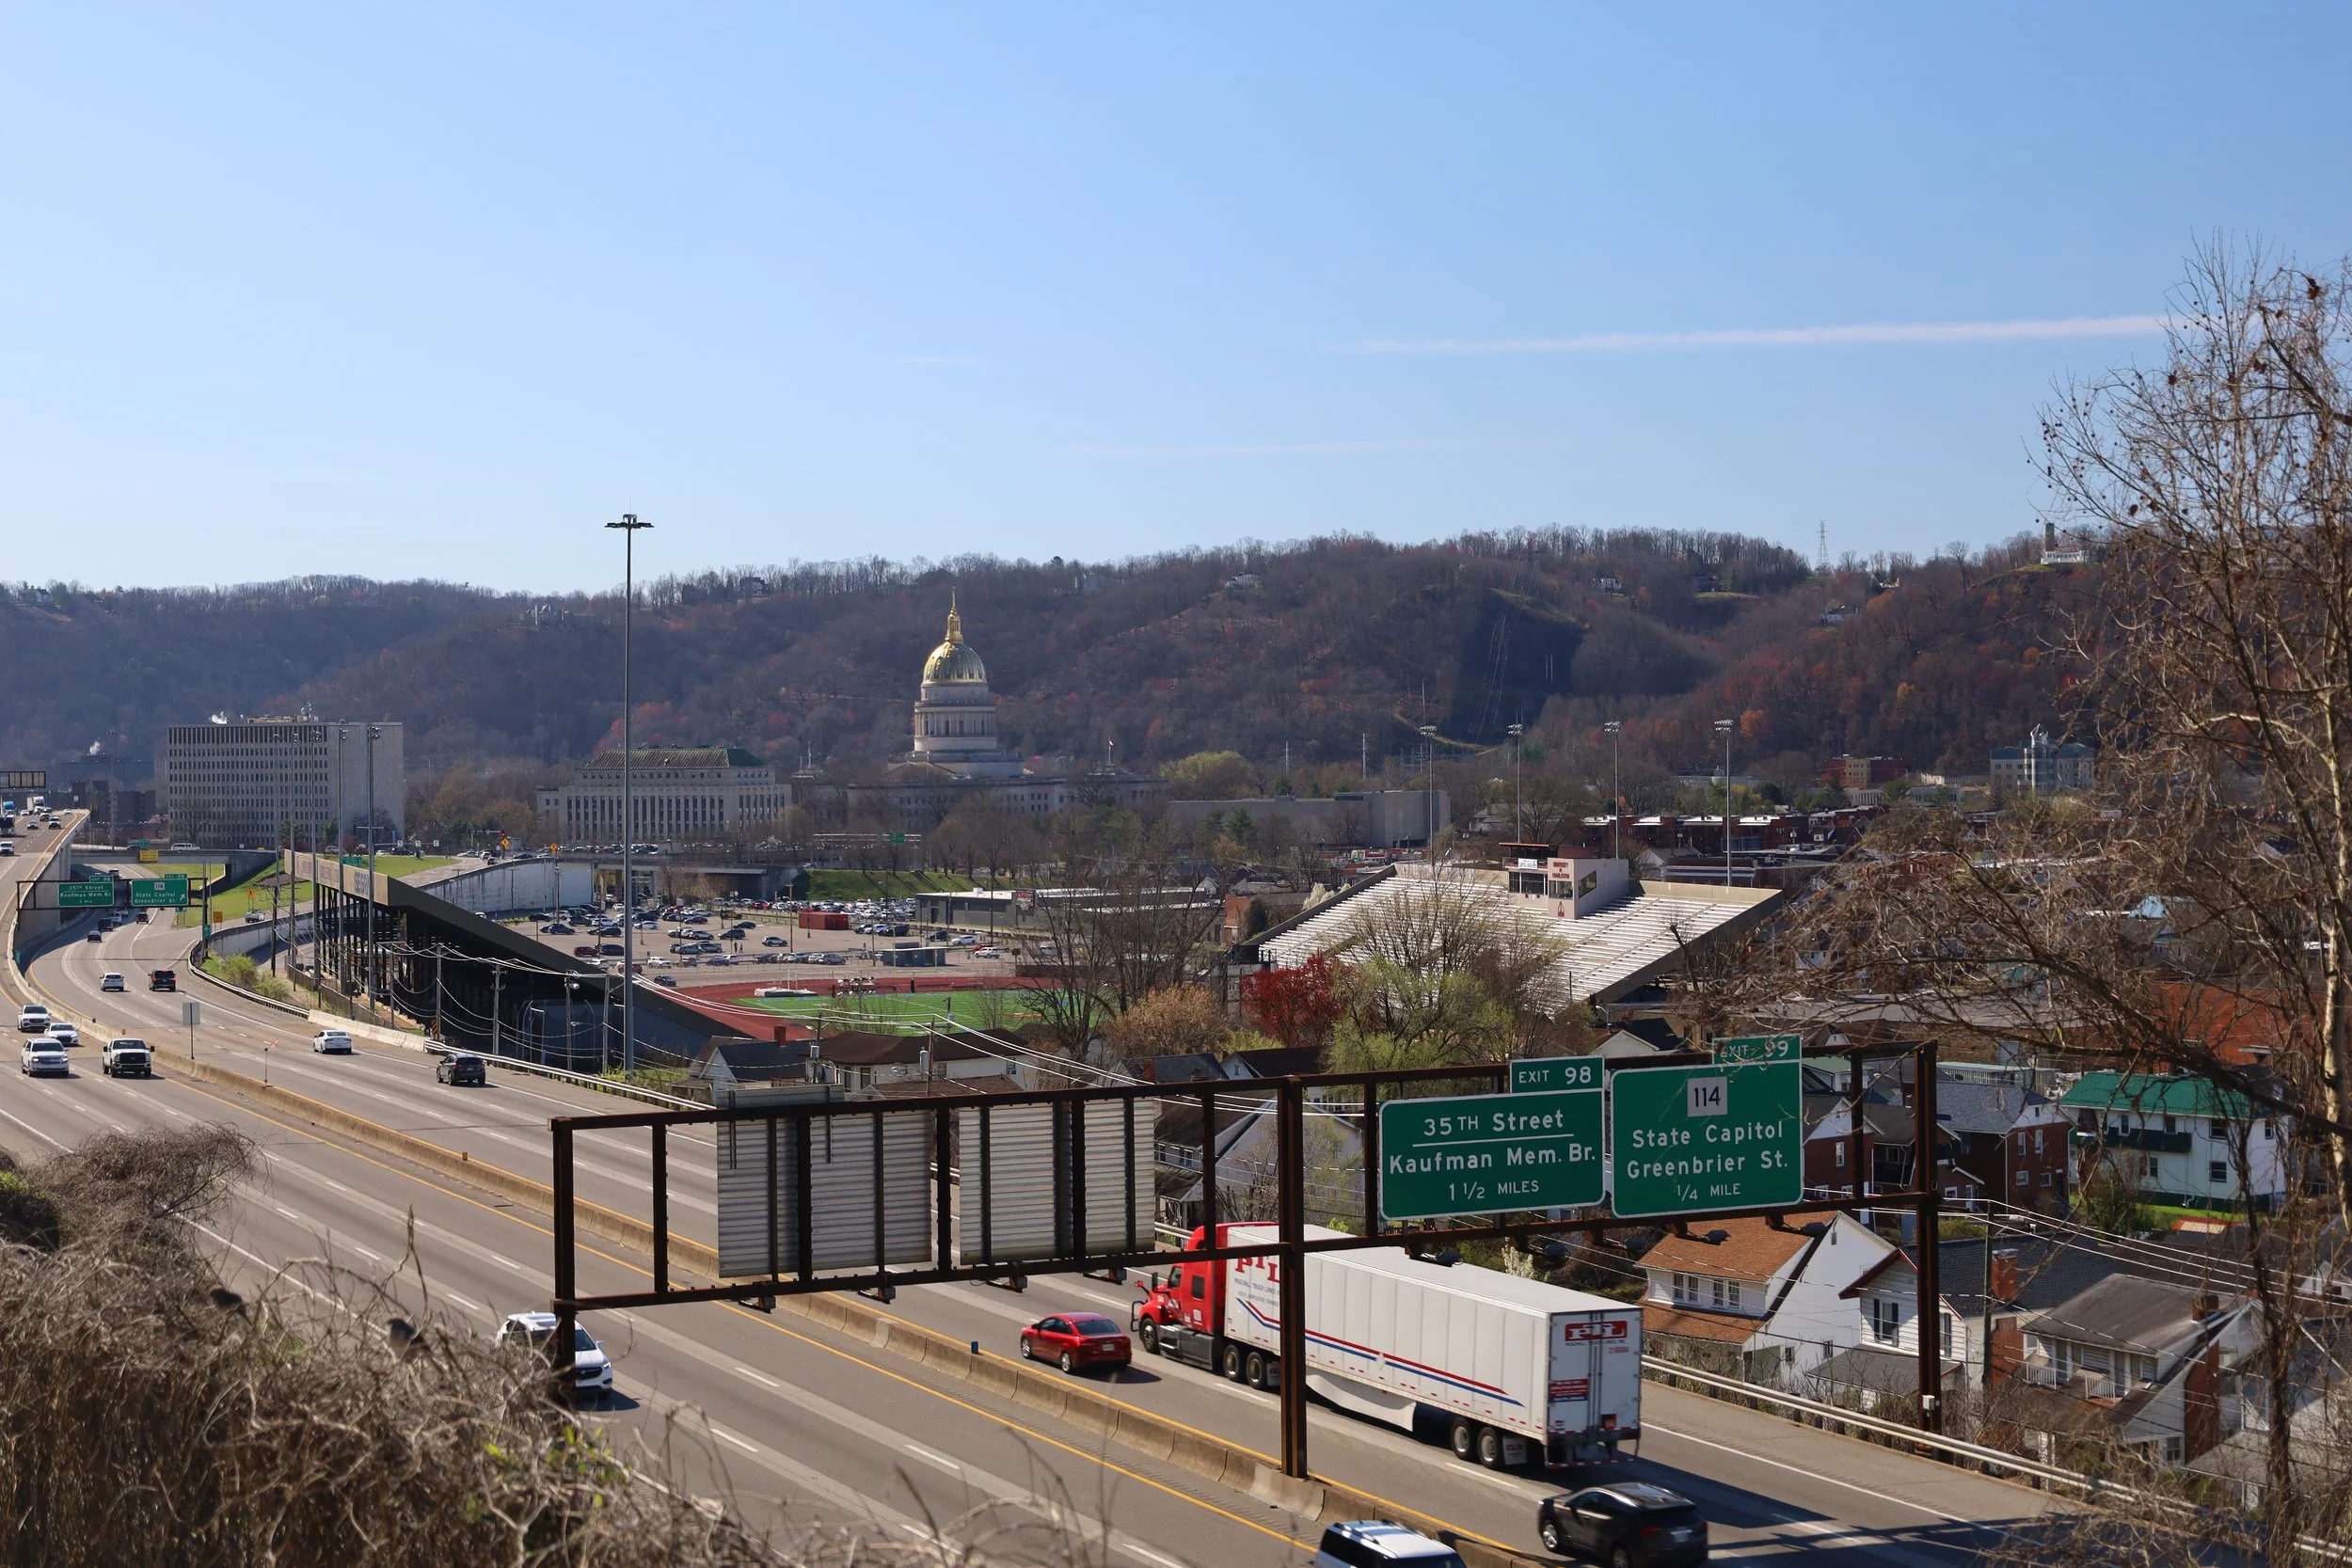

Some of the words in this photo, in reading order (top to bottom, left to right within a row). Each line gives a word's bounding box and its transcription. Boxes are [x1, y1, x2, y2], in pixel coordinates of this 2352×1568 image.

[1720, 1045, 1748, 1058] EXIT
[1764, 1040, 1789, 1058] 99
[1518, 1069, 1550, 1084] EXIT
[1565, 1066, 1592, 1085] 98
[1693, 1086, 1721, 1108] 114
[1423, 1115, 1479, 1136] 35TH
[1492, 1109, 1564, 1132] Street
[1632, 1128, 1691, 1148] State
[1705, 1121, 1783, 1144] Capitol
[1390, 1152, 1492, 1175] Kaufman
[1507, 1147, 1562, 1166] Mem.
[1569, 1143, 1596, 1163] Br.
[1627, 1154, 1746, 1180] Greenbrier
[1761, 1150, 1788, 1170] St.
[1497, 1180, 1540, 1196] MILES
[1676, 1184, 1699, 1202] 1/4
[1710, 1183, 1741, 1197] MILE
[1568, 1323, 1625, 1340] PTL
